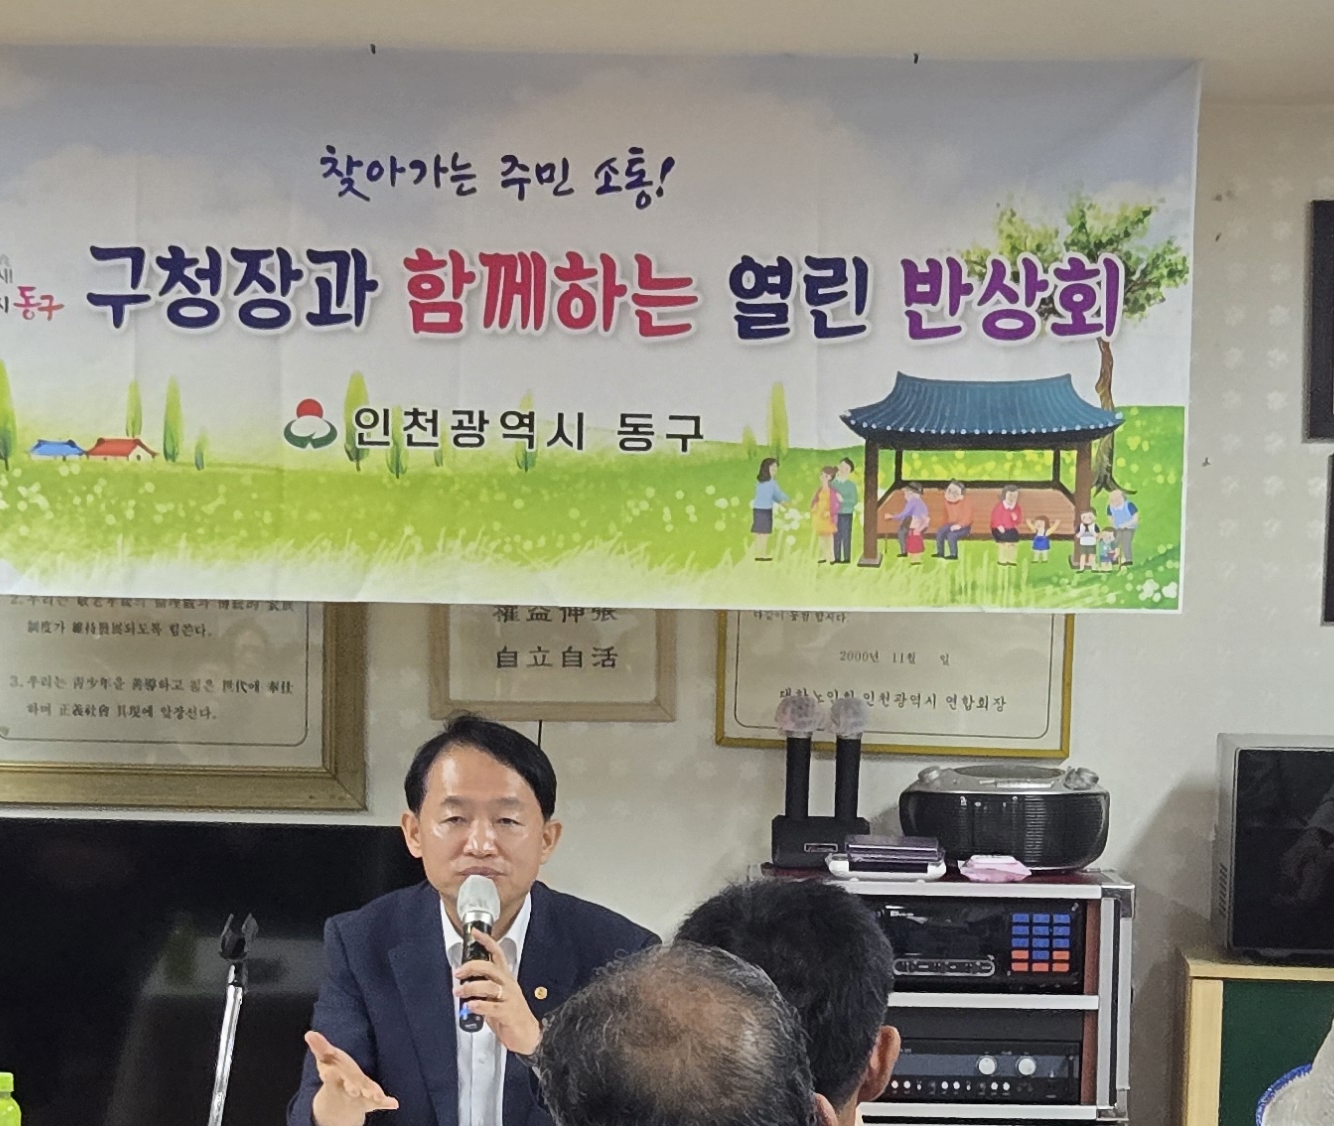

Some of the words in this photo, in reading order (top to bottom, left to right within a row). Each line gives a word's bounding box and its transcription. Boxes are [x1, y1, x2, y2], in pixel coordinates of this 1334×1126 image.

[320, 145, 476, 201] 찾아가는
[500, 156, 574, 200] 주민
[595, 147, 675, 209] 소통!
[14, 286, 65, 320] 동구
[87, 245, 378, 329] 구청장과
[403, 248, 698, 338] 함께하는
[729, 255, 867, 341] 열린
[903, 255, 1125, 340] 반상회
[354, 407, 586, 452] 인천광역시
[617, 412, 705, 453] 동구
[497, 645, 618, 668] 自立自活
[839, 650, 879, 663] 2000년
[862, 690, 936, 709] 인천광역시
[946, 693, 1007, 712] 연합회장
